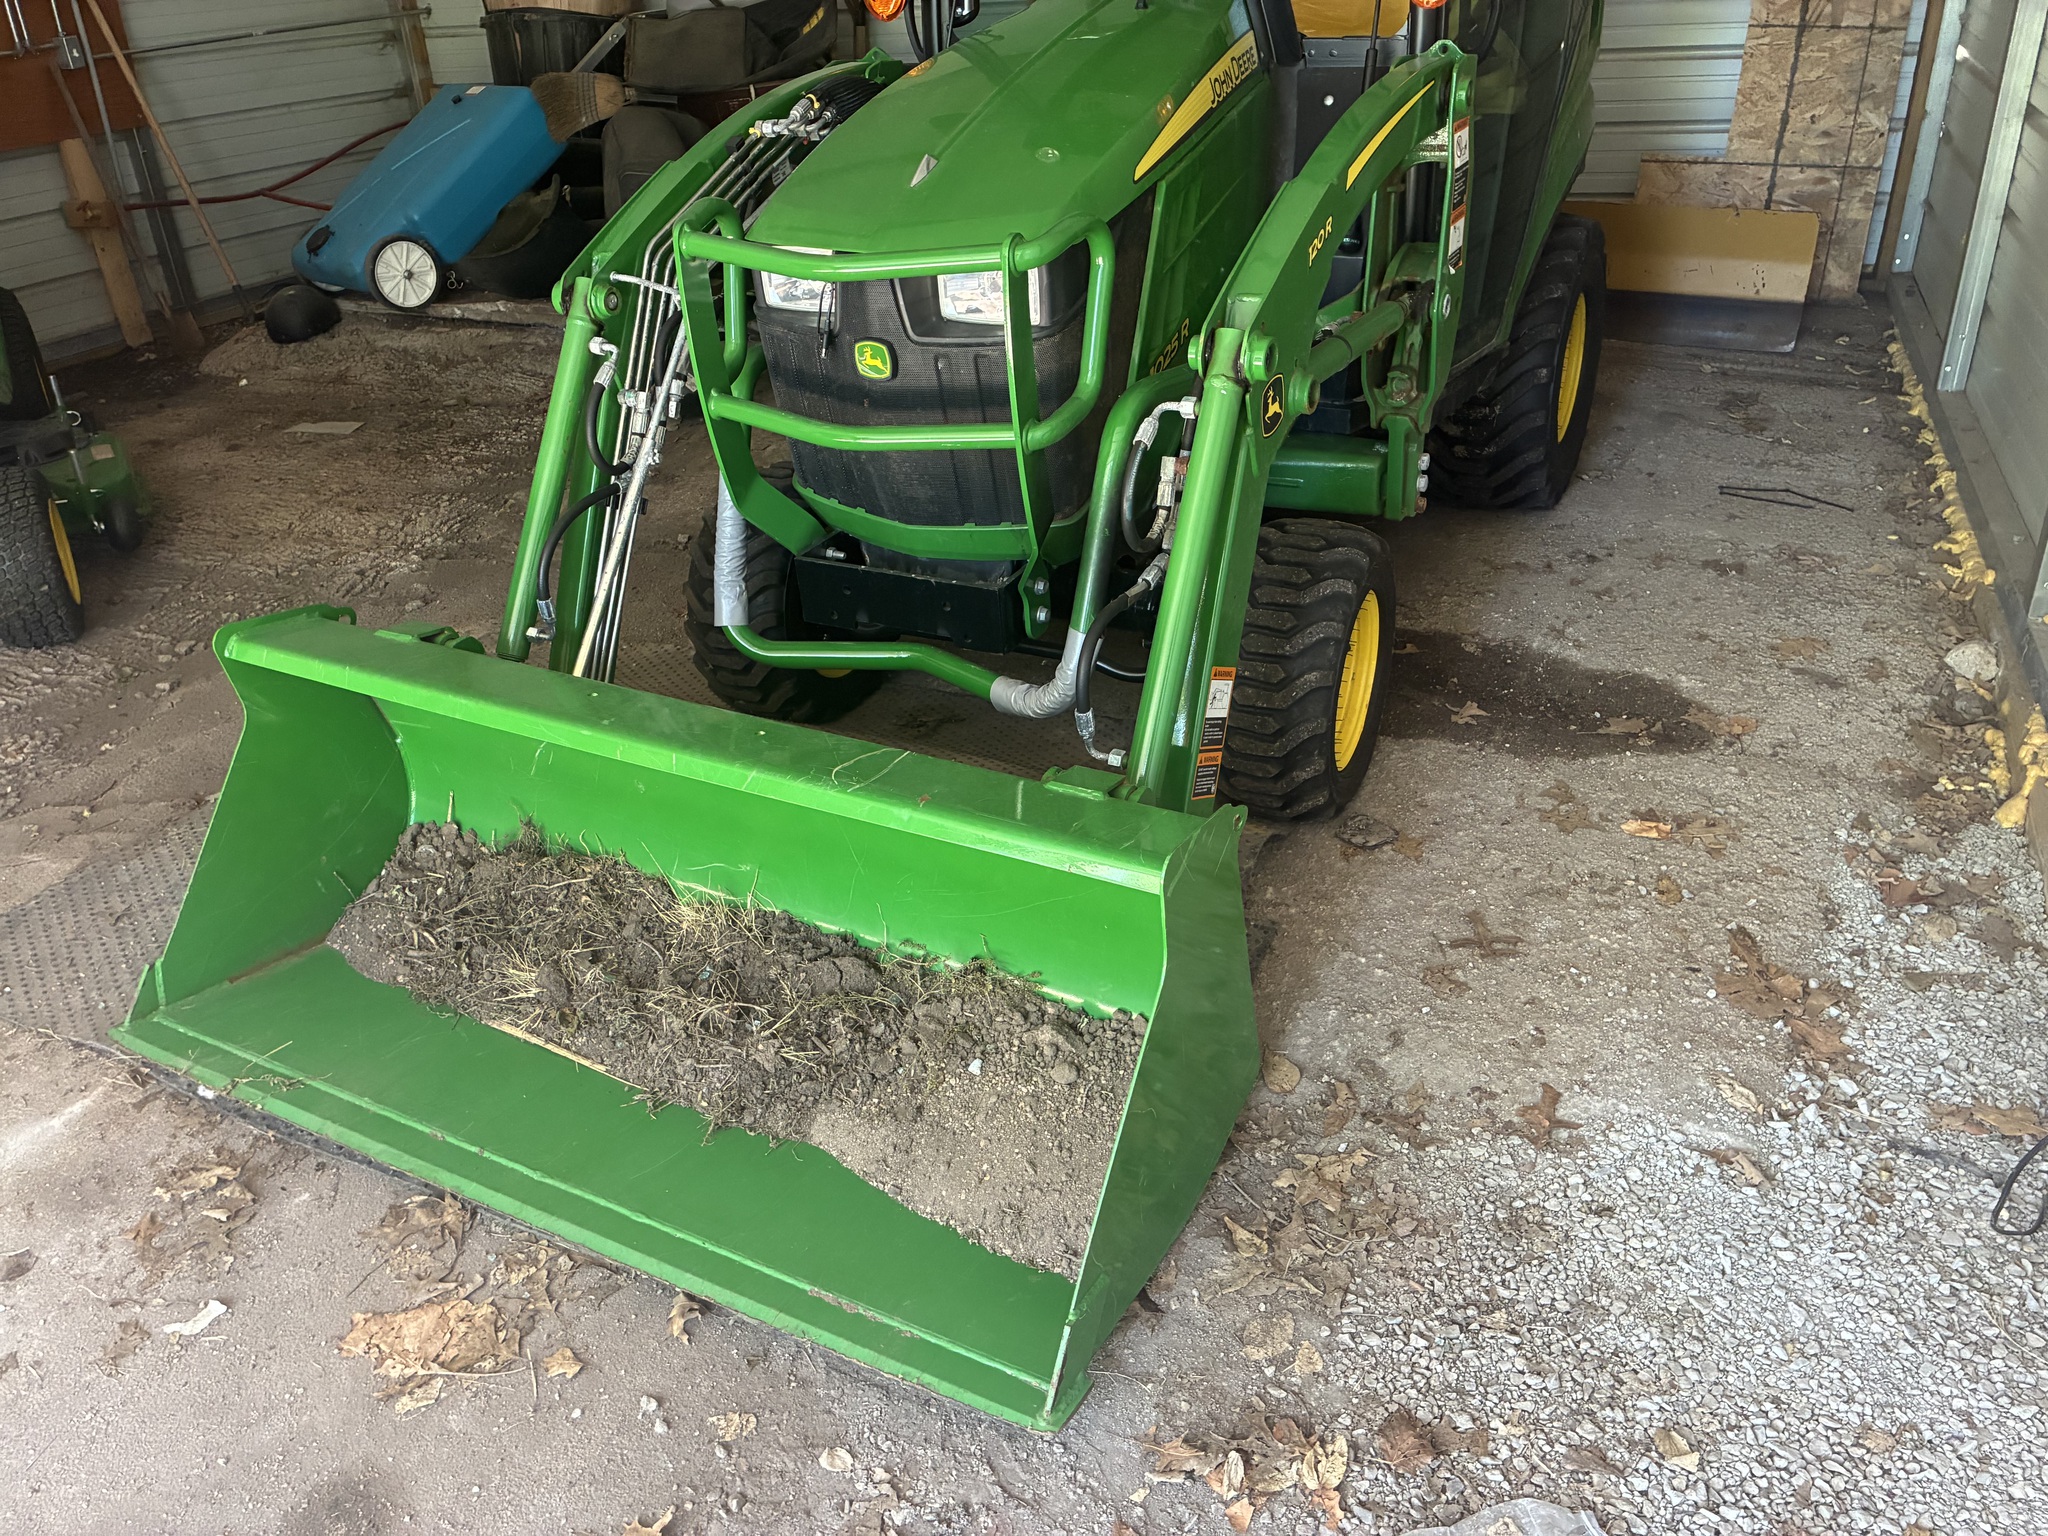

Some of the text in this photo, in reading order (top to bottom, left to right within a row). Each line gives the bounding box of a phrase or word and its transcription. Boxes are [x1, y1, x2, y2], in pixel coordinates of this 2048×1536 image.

[1209, 45, 1257, 105] JOHN DEERE
[1308, 215, 1333, 268] 120 R
[1180, 317, 1190, 345] R
[1217, 670, 1234, 678] WARNING
